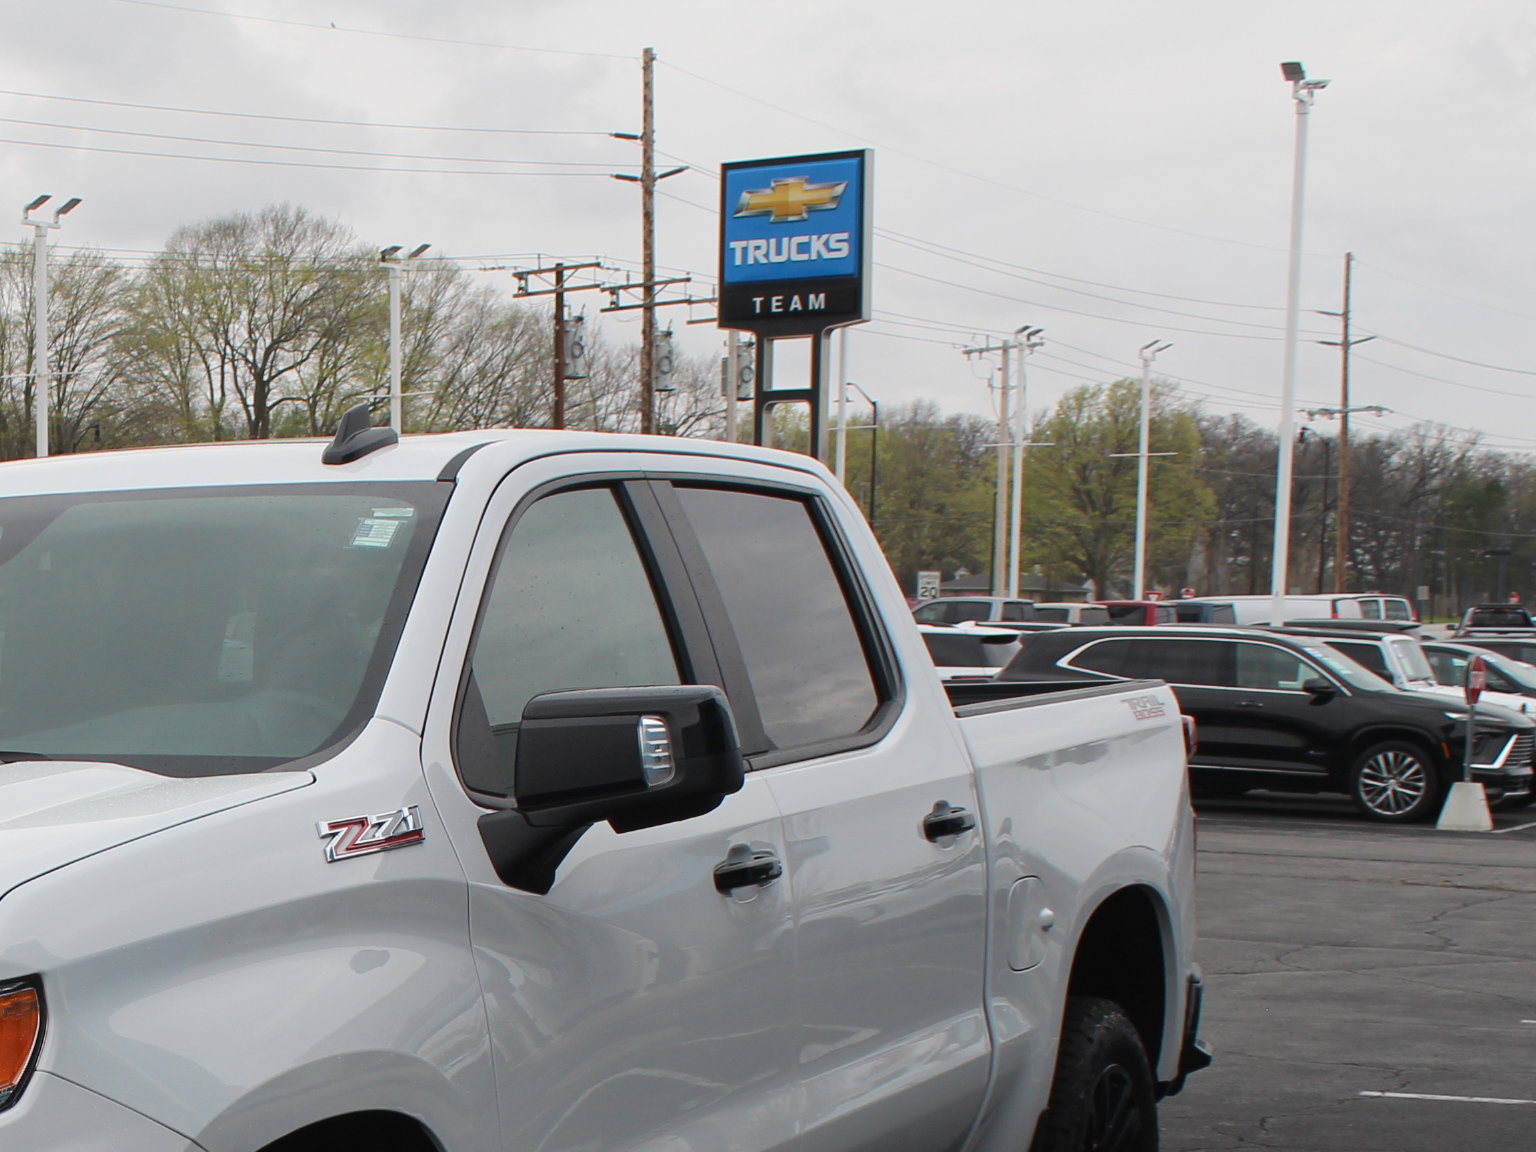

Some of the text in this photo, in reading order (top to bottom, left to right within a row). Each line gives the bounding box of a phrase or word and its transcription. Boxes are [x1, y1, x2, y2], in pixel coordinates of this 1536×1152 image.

[729, 232, 850, 266] TRUCKS
[752, 292, 826, 314] TEAM
[316, 804, 425, 863] Z71
